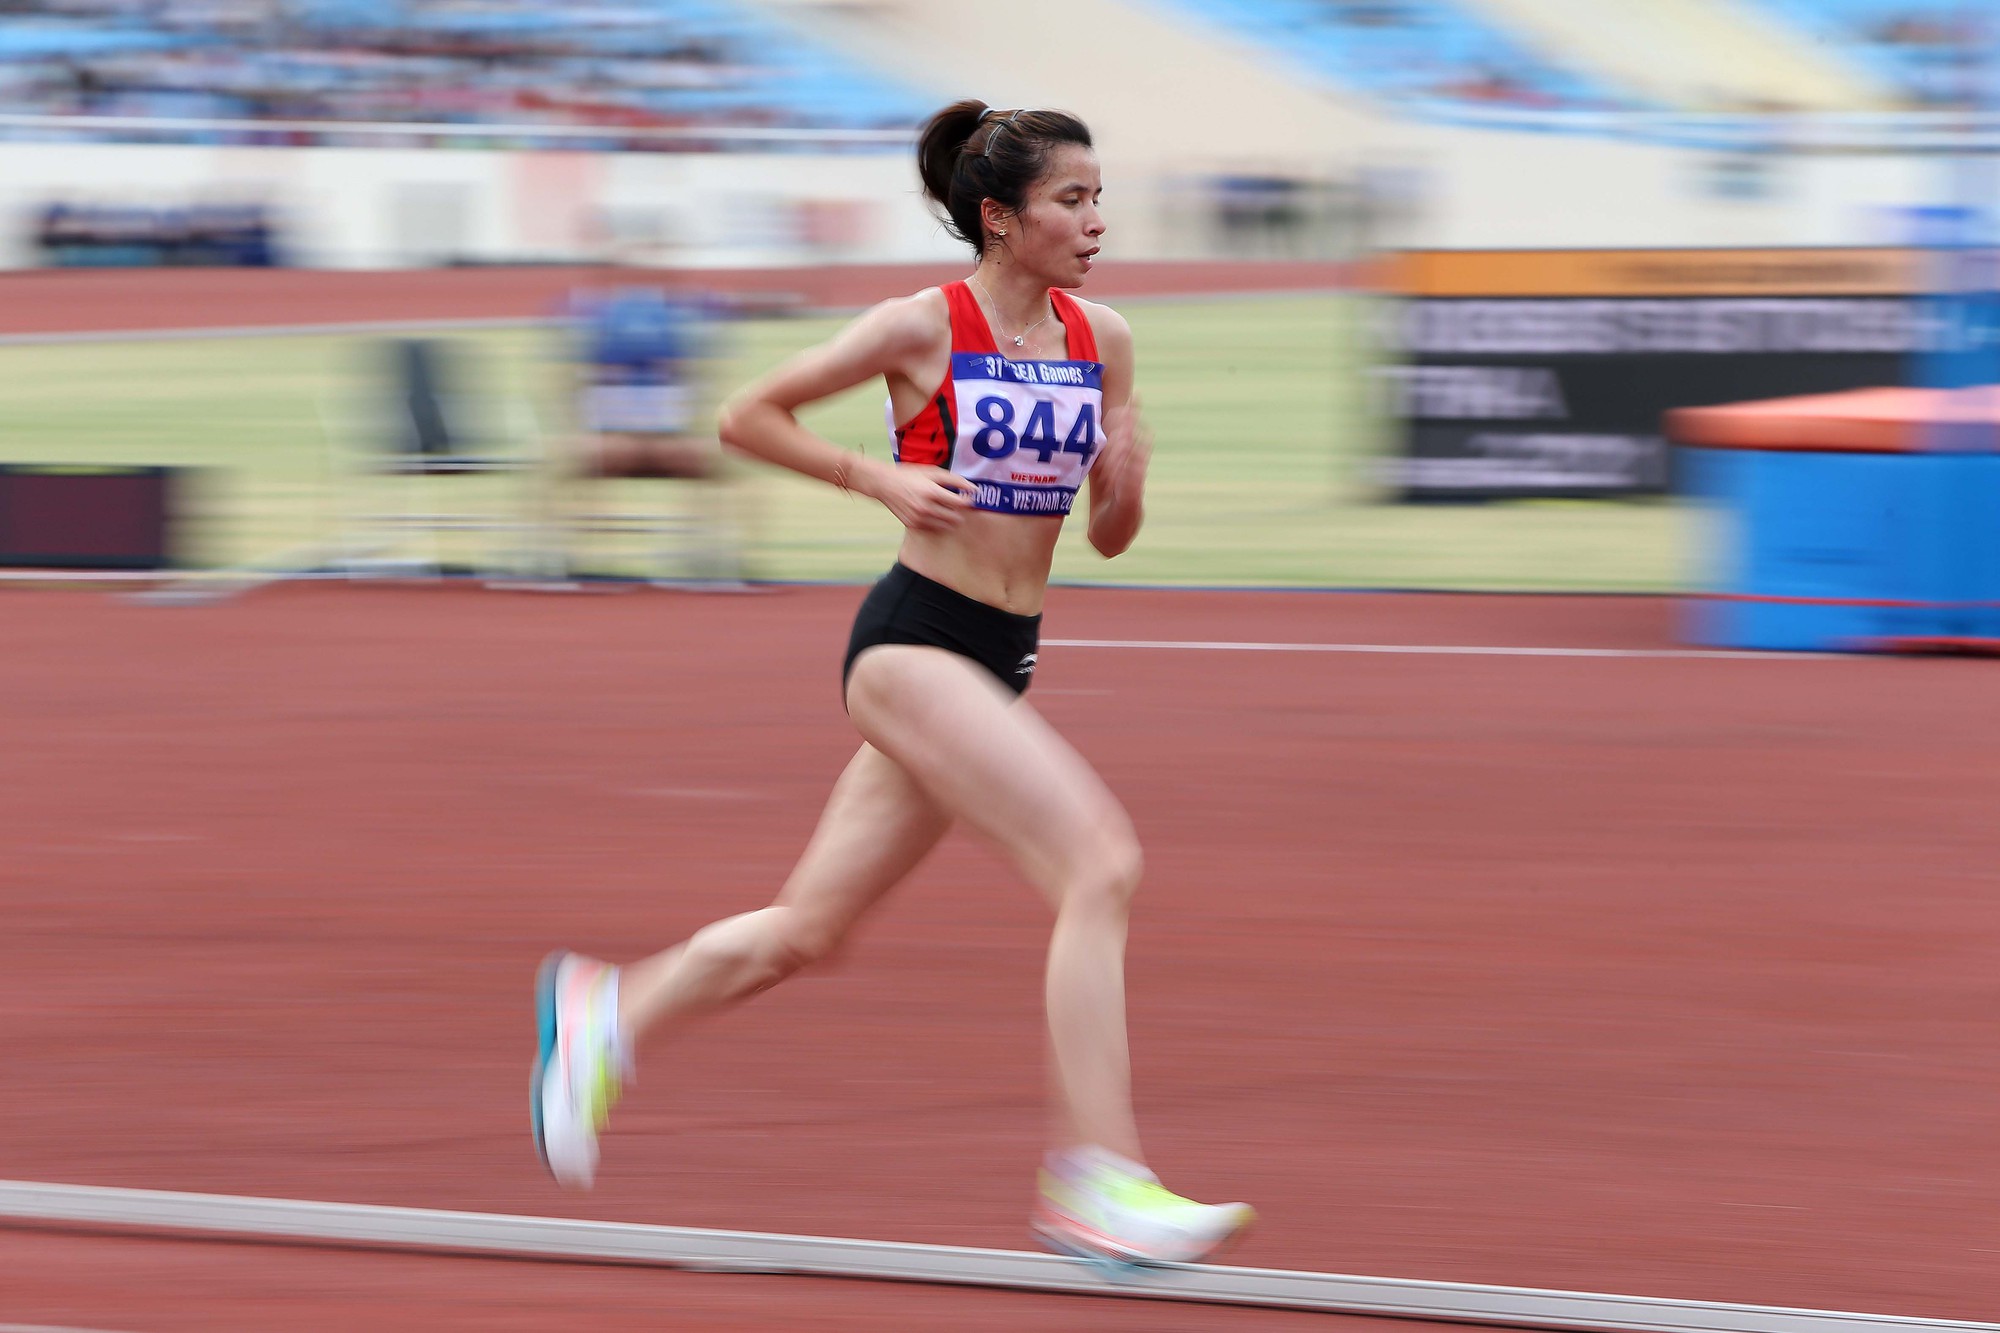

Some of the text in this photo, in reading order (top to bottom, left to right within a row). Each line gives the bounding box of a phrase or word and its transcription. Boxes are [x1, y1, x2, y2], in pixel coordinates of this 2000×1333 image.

[1038, 363, 1083, 384] Games
[972, 397, 1096, 466] 844
[1011, 472, 1057, 484] VIETNAM
[1013, 489, 1060, 511] VIETNAM
